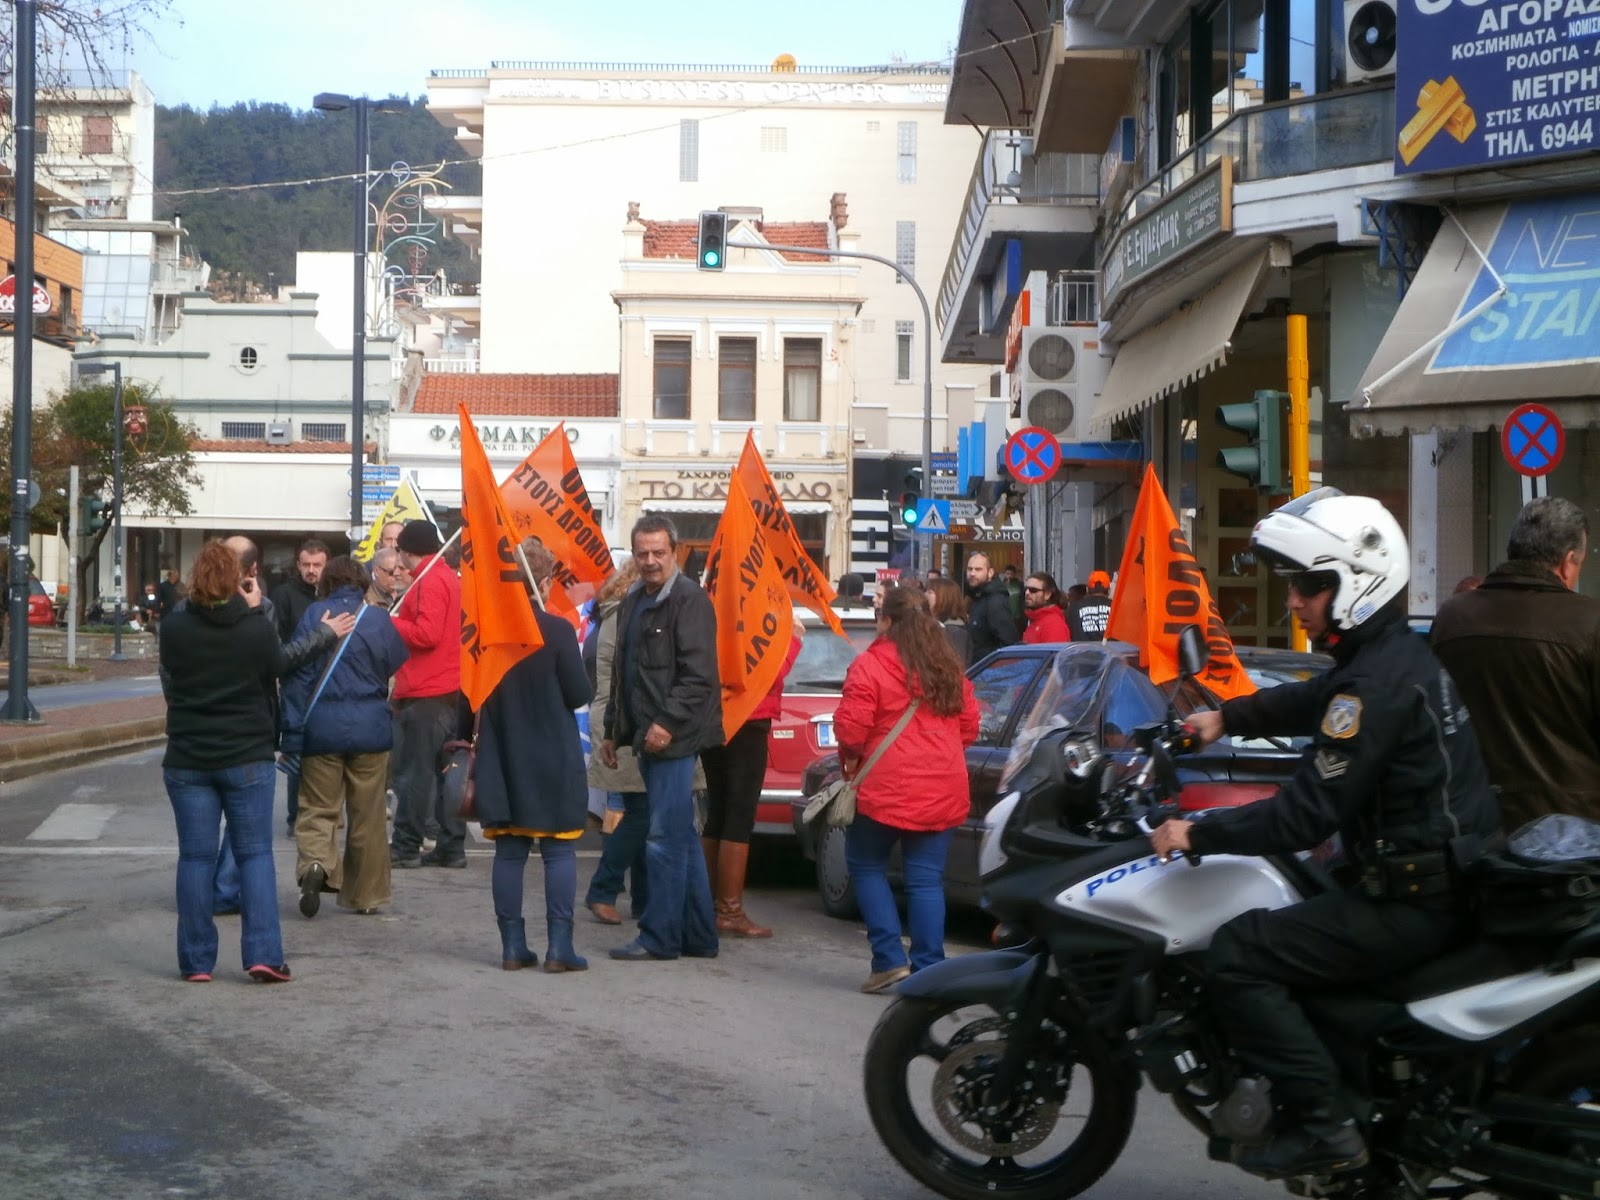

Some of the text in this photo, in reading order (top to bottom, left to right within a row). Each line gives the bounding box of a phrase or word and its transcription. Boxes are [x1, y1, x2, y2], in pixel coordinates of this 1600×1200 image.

[1452, 27, 1557, 60] ΚΟΣΜΗΜΑΤΑ
[1568, 16, 1600, 38] ΝΟΜΙΣ
[1506, 44, 1579, 71] ΡΟΛΟΓΙΑ
[598, 79, 746, 100] BUSINESS
[765, 81, 890, 102] CENTER
[1512, 66, 1600, 102] ΜΕΤΡΗ
[1486, 107, 1522, 128] ΣΤΙΣ
[1484, 118, 1594, 158] ΤΗΛ. 6944
[429, 425, 580, 444] ΦΑΜΑΚΕΟ
[639, 481, 684, 499] ΤΟ
[514, 462, 616, 575] ΣΤΟΥΣ ΔΡΟΜΟΥ
[983, 531, 1025, 541] EPHO
[1086, 849, 1184, 898] POLIE
